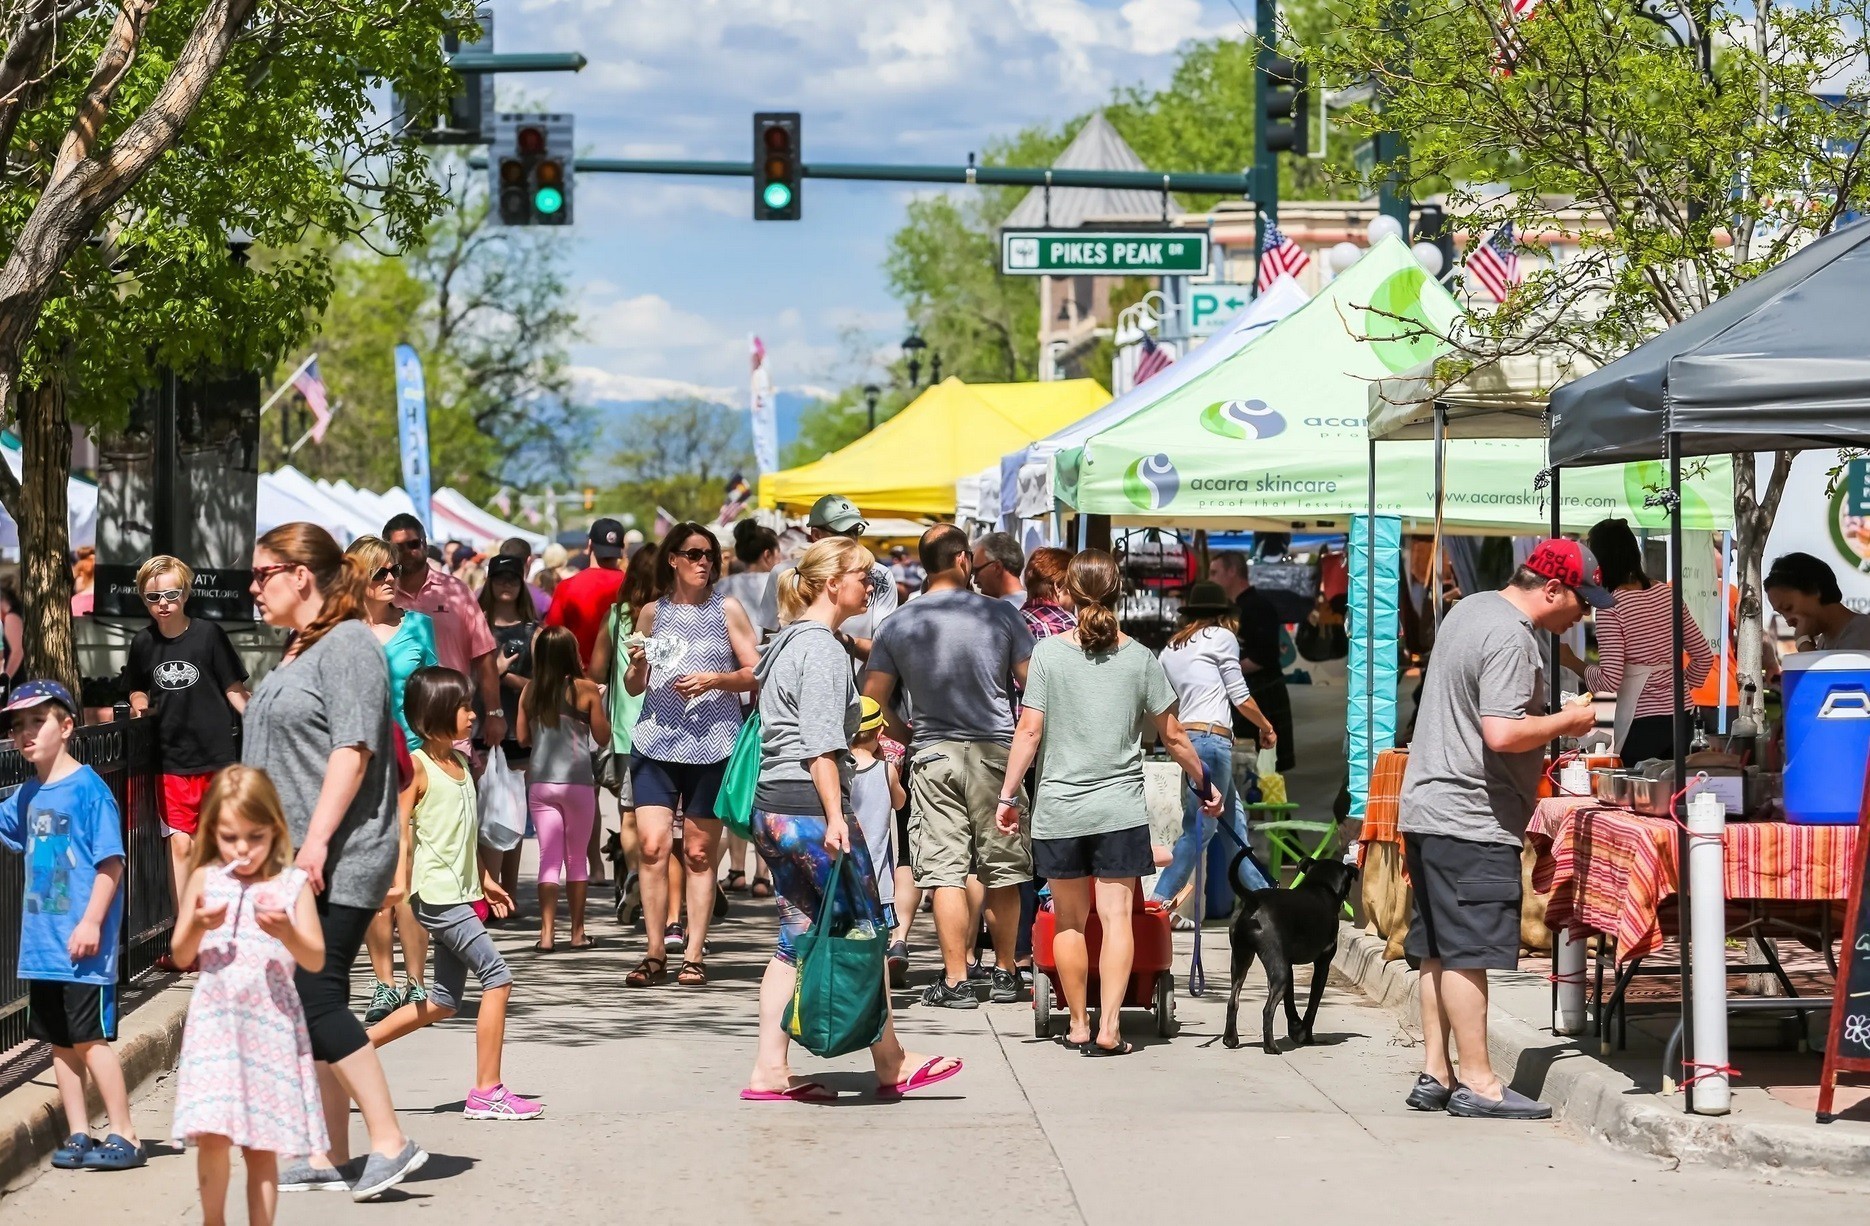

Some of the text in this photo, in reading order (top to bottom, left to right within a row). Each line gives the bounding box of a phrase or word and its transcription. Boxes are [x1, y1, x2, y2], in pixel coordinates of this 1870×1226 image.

[1050, 242, 1107, 265] PIKES
[1113, 242, 1163, 265] PEAK
[1193, 294, 1218, 326] P
[1303, 416, 1367, 427] acar
[1190, 472, 1337, 493] acara skincare
[1199, 499, 1243, 509] proof
[1254, 499, 1286, 508] that
[1297, 499, 1329, 508] less
[1340, 500, 1352, 508] is
[1426, 489, 1616, 508] www.acaraskincre.com
[1540, 548, 1567, 565] red
[1528, 553, 1580, 584] wings
